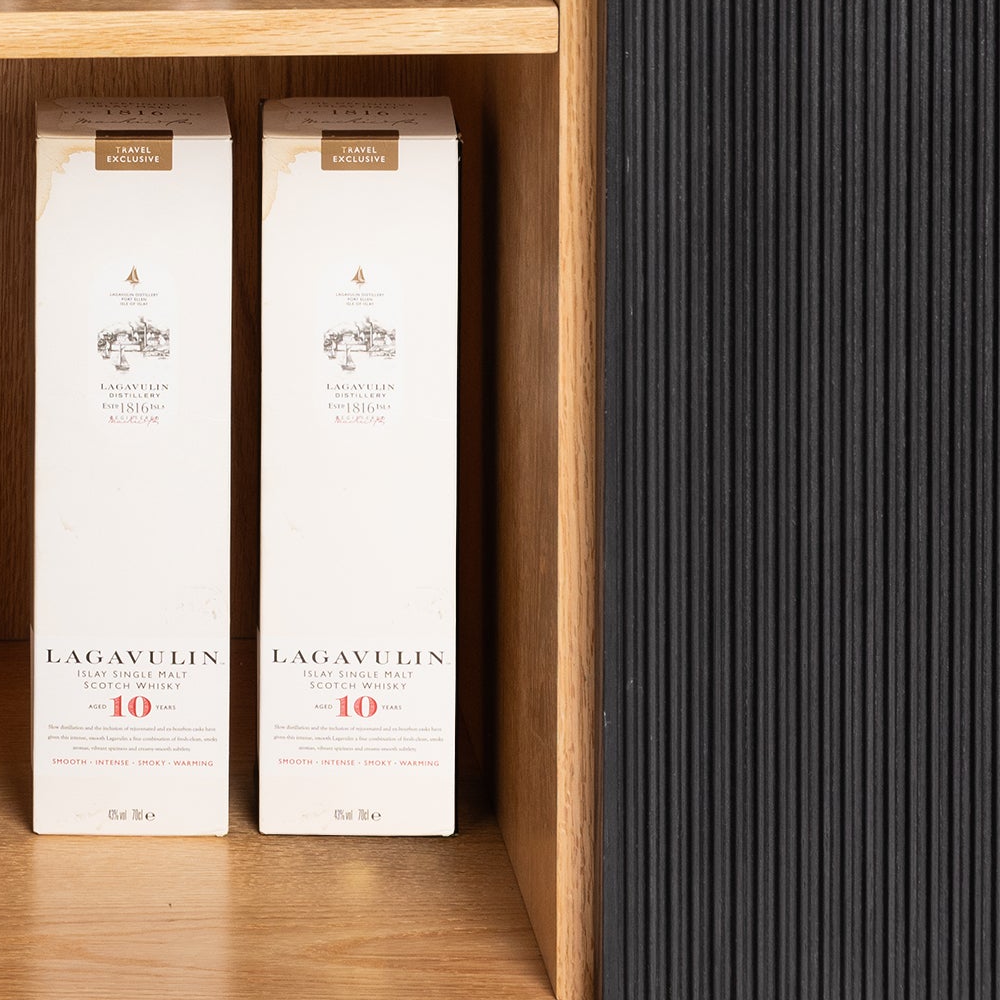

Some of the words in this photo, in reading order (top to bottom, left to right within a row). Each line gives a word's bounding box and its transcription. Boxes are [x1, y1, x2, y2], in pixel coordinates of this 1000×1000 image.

[115, 146, 151, 154] TRAVEL
[341, 146, 377, 154] TRAVEL
[106, 155, 160, 163] EXCLUSIVE
[332, 155, 386, 163] EXCLUSIVE
[121, 402, 149, 413] 1816
[347, 402, 375, 413] 1816
[46, 649, 218, 665] LAGAVULIN
[272, 649, 444, 665] LAGAVULIN
[77, 669, 107, 678] ISLAY
[113, 670, 152, 679] SINGLE
[158, 671, 188, 679] MALT
[303, 669, 333, 678] ISLAY
[339, 670, 378, 679] SINGLE
[384, 671, 414, 679] MALT
[84, 682, 130, 690] SCOTCH
[136, 682, 181, 690] WHISKY
[310, 682, 356, 690] SCOTCH
[362, 682, 407, 690] WHISKY
[109, 695, 152, 718] 10
[336, 695, 378, 718] 10
